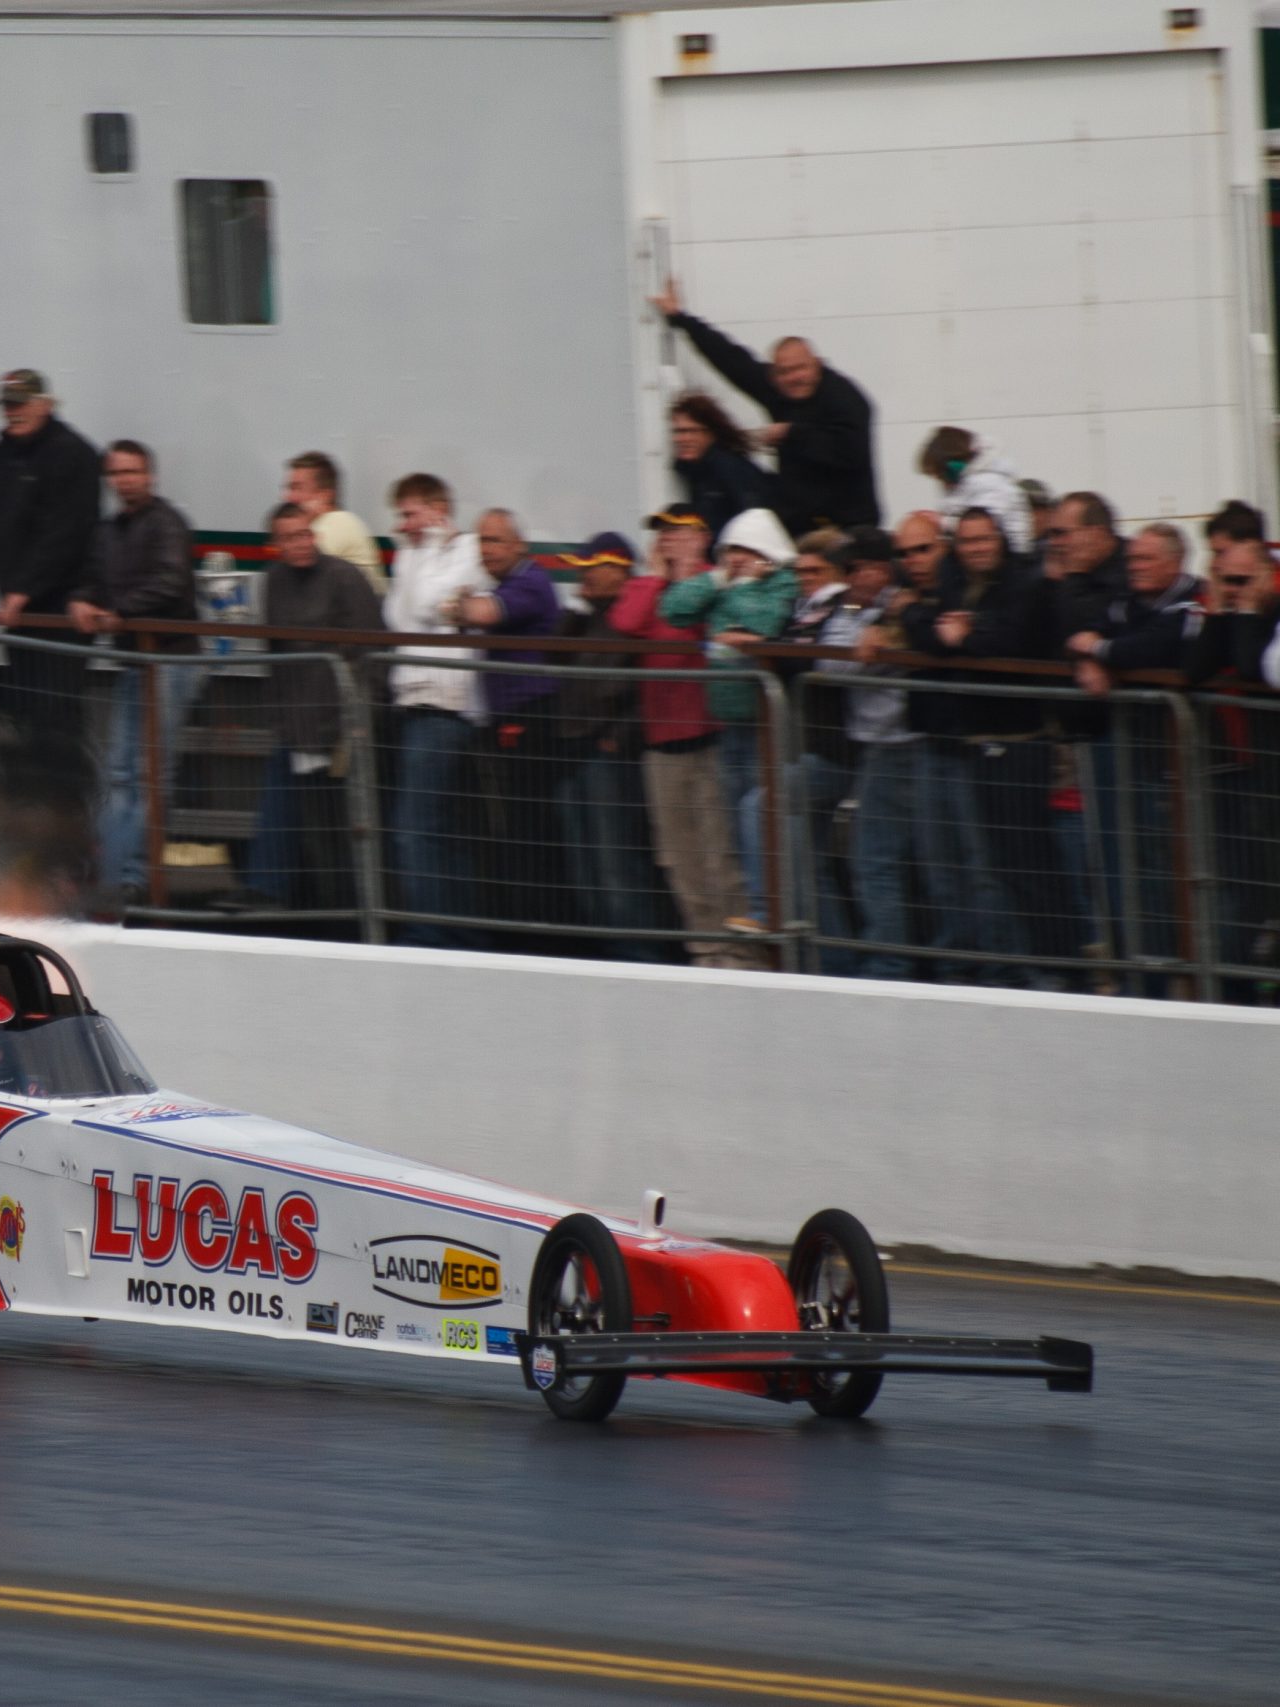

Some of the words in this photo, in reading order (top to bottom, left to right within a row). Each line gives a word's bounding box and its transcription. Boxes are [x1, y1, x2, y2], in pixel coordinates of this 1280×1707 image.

[90, 1168, 319, 1285] LUCAS
[372, 1254, 498, 1292] LANDMECO
[127, 1277, 216, 1312] MOTOR
[228, 1289, 284, 1320] OILS
